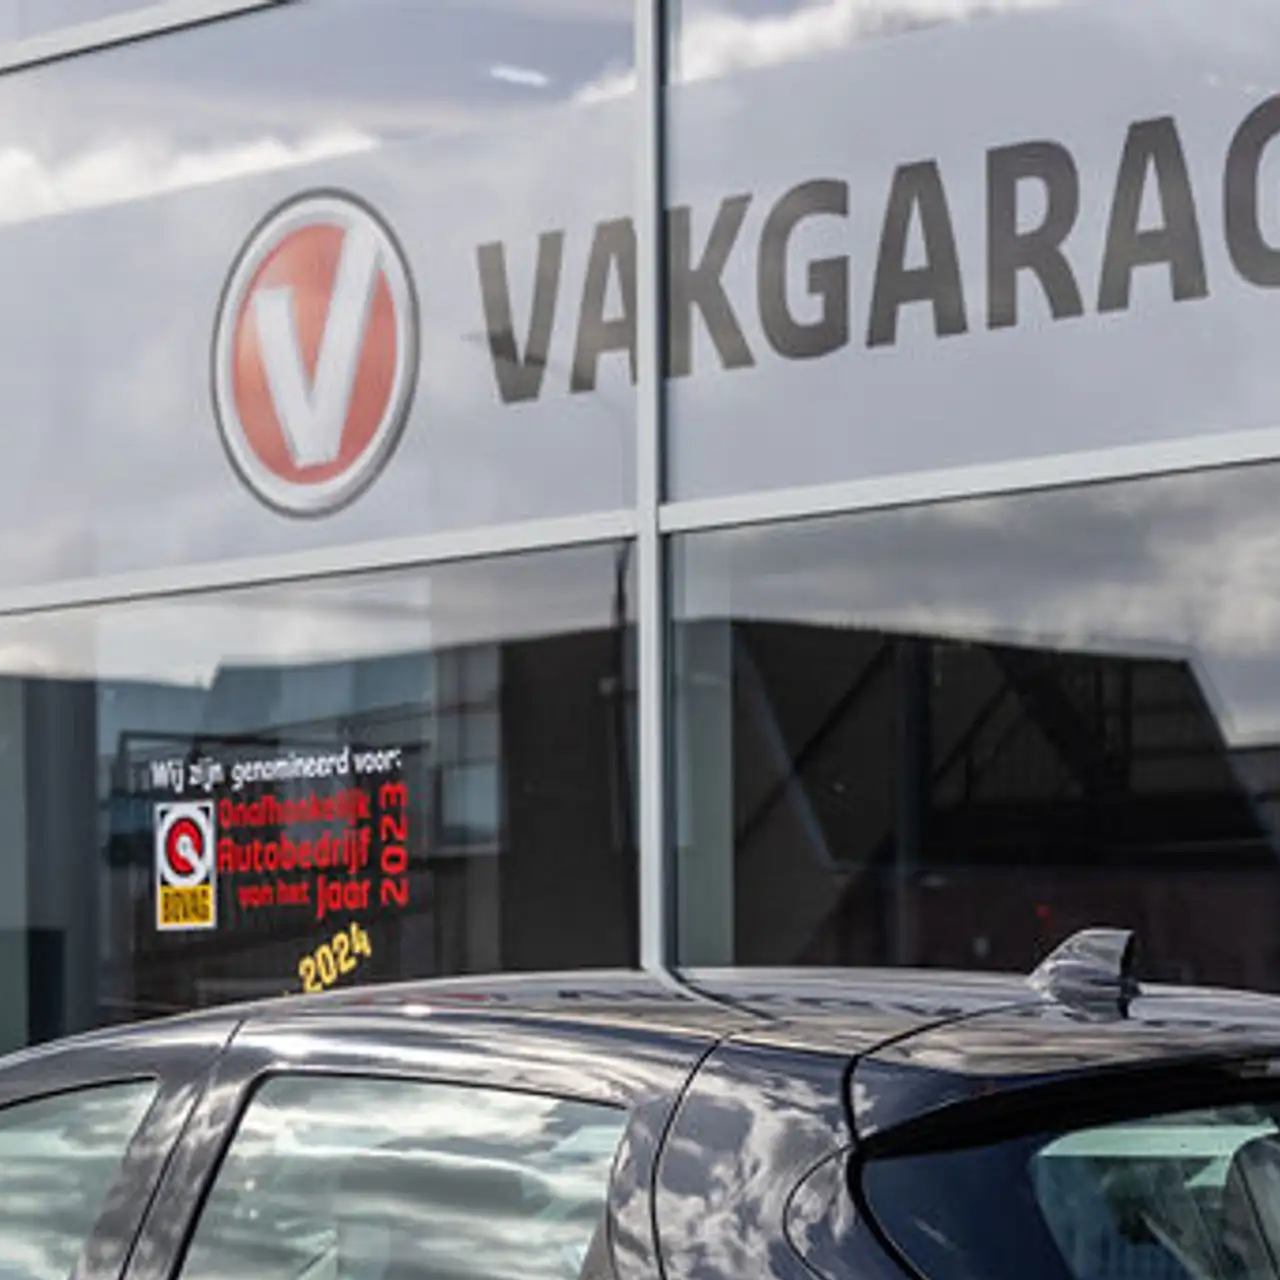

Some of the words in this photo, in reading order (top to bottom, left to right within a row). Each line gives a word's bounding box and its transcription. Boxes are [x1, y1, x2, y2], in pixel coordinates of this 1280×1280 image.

[151, 759, 184, 793] Wij
[189, 757, 224, 792] zijn
[231, 746, 350, 791] genomineerd
[217, 827, 371, 874] Autobedrijf
[379, 782, 407, 907] 2023
[298, 921, 371, 993] 2024
